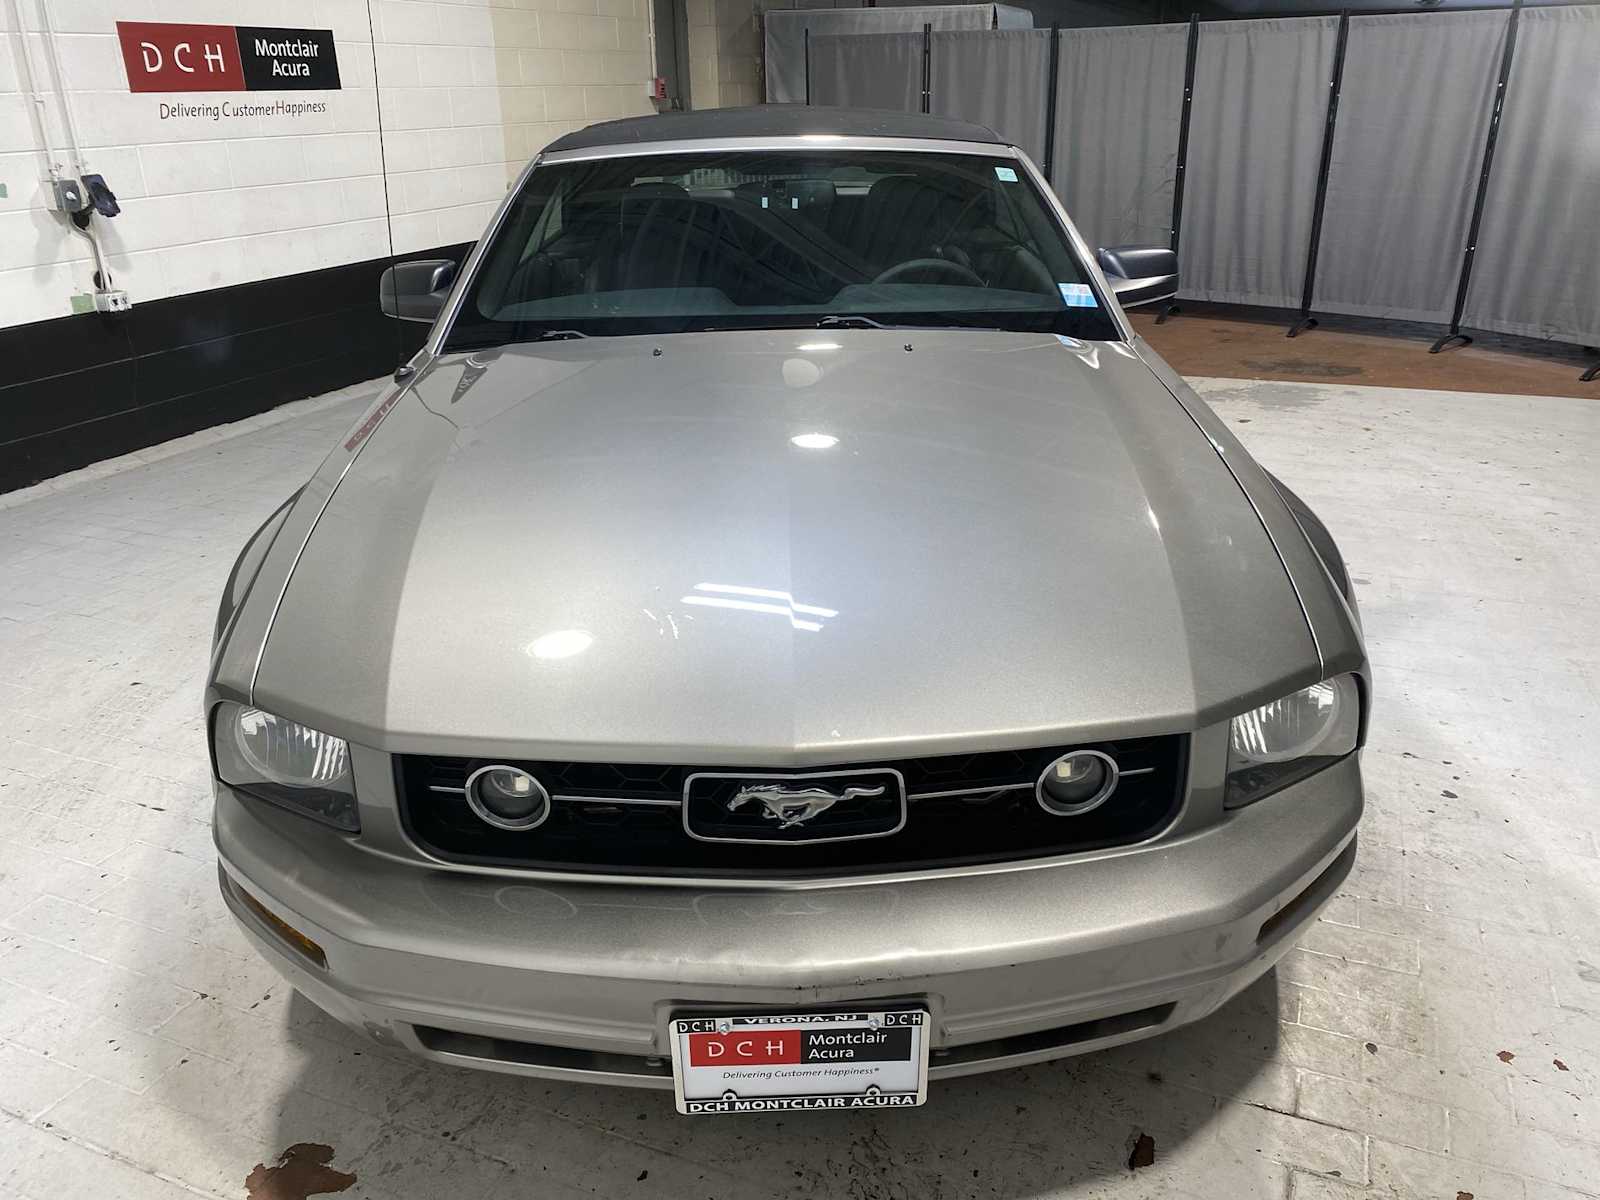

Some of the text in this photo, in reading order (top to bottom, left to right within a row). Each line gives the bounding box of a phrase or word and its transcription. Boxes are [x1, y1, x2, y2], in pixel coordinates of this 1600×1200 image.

[255, 39, 319, 57] Montclair
[141, 42, 225, 73] DCH
[272, 59, 310, 76] Acura
[159, 102, 219, 120] Delivering
[679, 1021, 715, 1033] DCH
[886, 1014, 921, 1025] DCH
[809, 1032, 888, 1045] Montclair
[708, 1040, 784, 1057] DCH
[809, 1049, 854, 1059] Acura
[723, 1071, 772, 1079] Delivering
[774, 1069, 822, 1078] Customer
[689, 1096, 914, 1112] DCH MONTCLAIR ACURA
